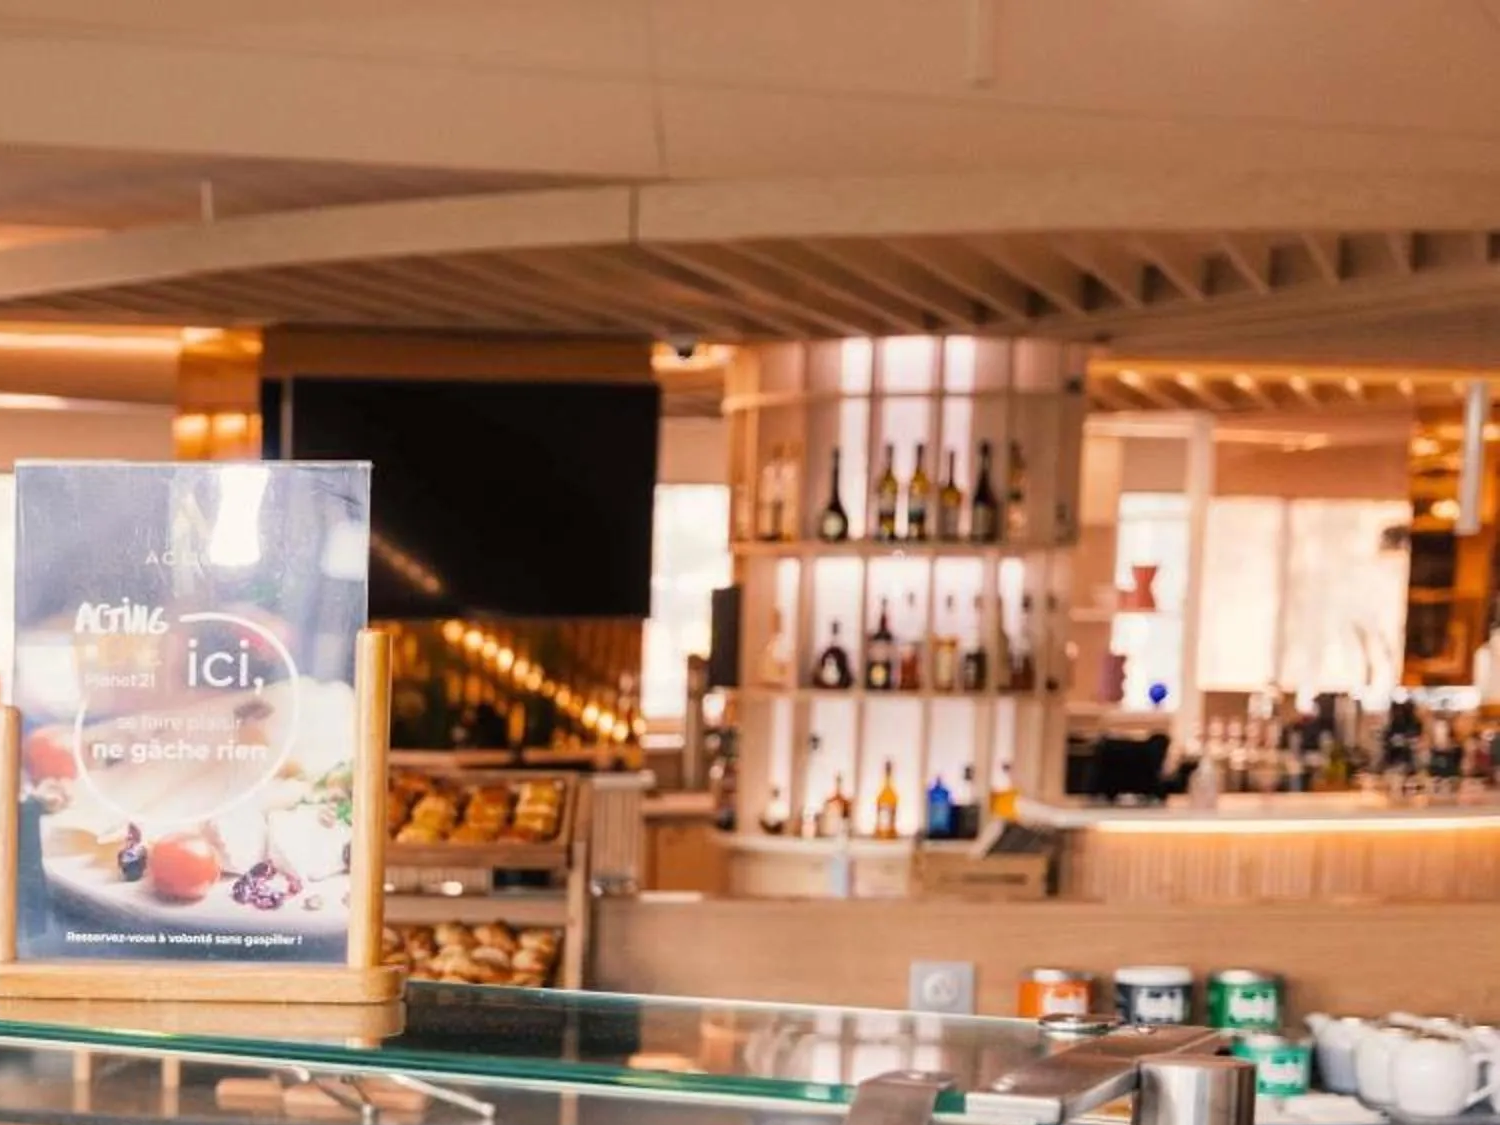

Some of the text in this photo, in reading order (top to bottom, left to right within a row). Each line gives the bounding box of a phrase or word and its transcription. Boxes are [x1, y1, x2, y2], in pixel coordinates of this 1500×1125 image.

[188, 639, 264, 696] ici,
[93, 742, 125, 760] ne
[217, 740, 269, 760] rien
